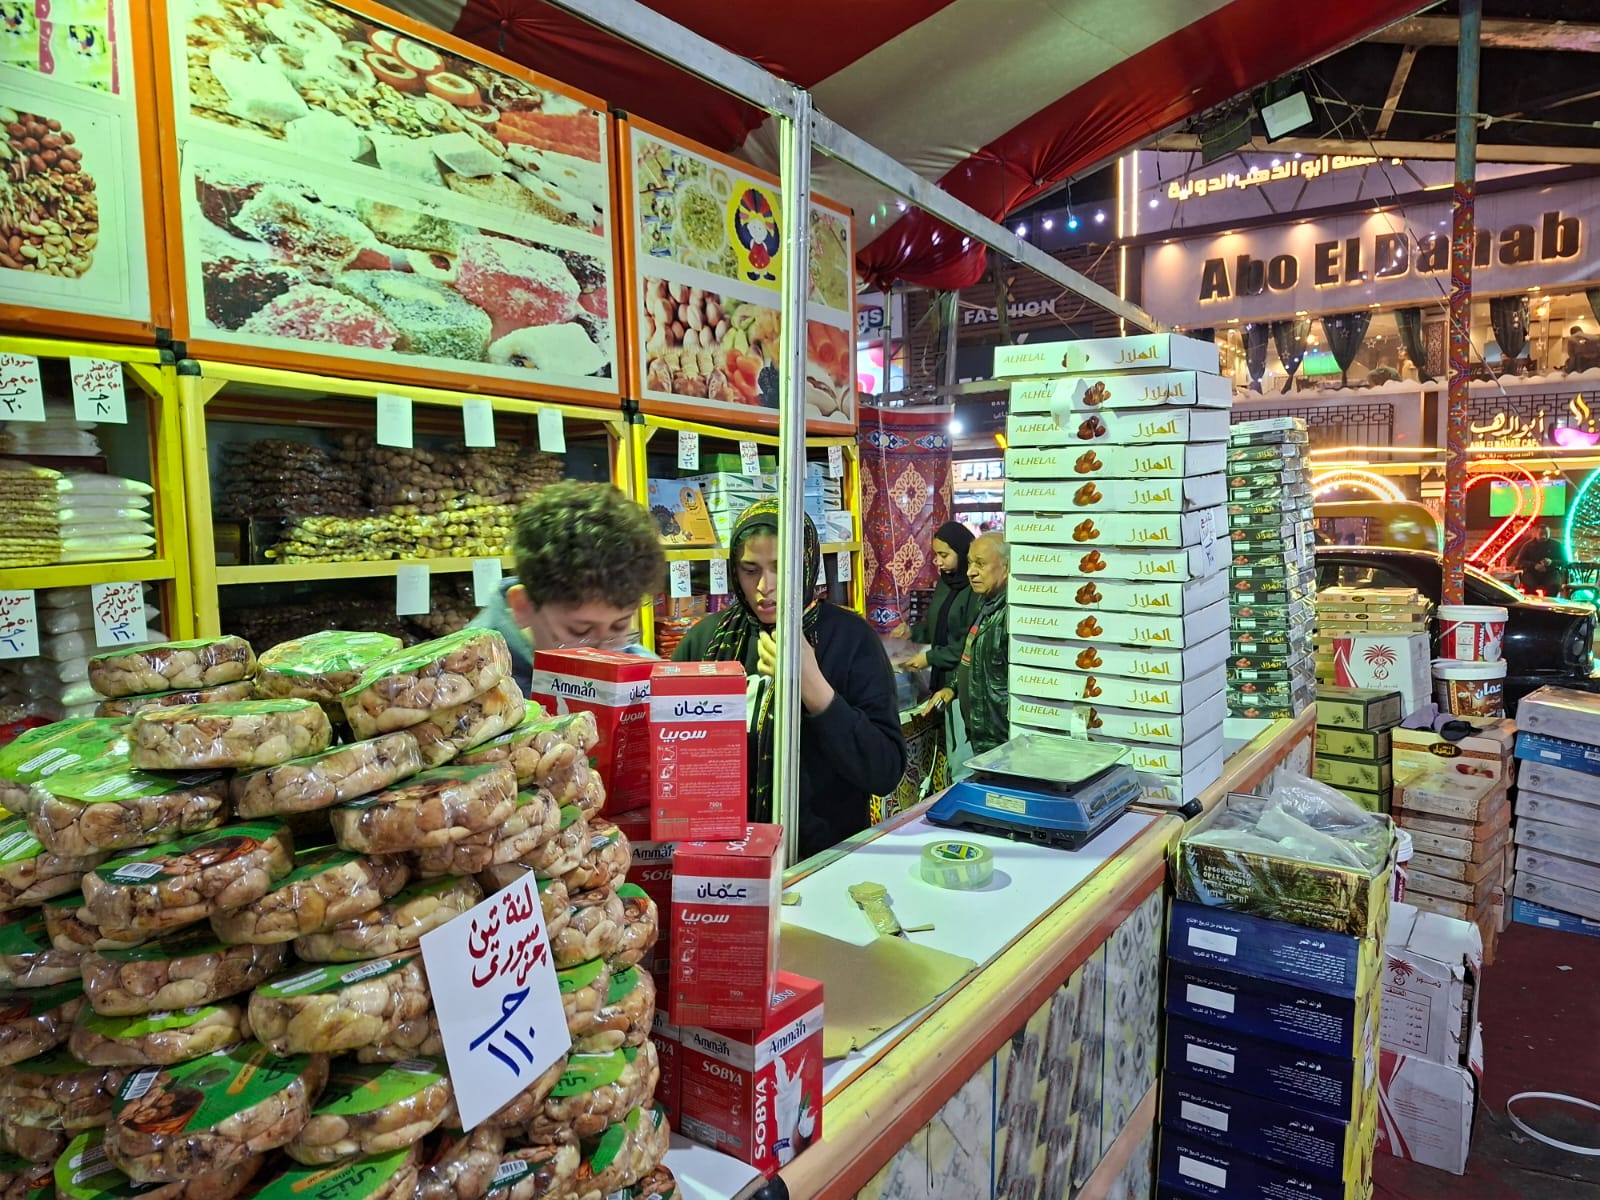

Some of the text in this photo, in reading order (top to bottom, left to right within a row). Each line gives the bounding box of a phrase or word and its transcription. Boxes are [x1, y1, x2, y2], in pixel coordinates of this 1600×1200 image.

[1200, 253, 1299, 302] Abo
[1114, 345, 1160, 365] الهلال
[1019, 388, 1052, 400] ALHEL
[1131, 419, 1181, 438] الهلال
[1128, 455, 1176, 473] الهلال
[1127, 487, 1175, 505] الهلال
[1013, 523, 1056, 532] ALHELAL
[1125, 526, 1172, 543] الهلال
[1018, 554, 1062, 563] ALHELAL
[1131, 559, 1179, 576] الهلال
[1016, 584, 1059, 594] ALHELAL
[1127, 592, 1176, 609] الهلال
[1016, 616, 1060, 627] ALHELAL
[1127, 627, 1175, 642] الهلال
[1017, 645, 1060, 657] ALHELAL
[1127, 659, 1174, 676] الهلال
[551, 677, 596, 699] Amman
[1016, 674, 1059, 686] ALHELAL
[1126, 688, 1173, 705] الهلال
[1017, 703, 1061, 717] ALHELAL
[658, 727, 708, 743] سوبيا
[1127, 721, 1174, 738] الهلال
[1129, 751, 1170, 769] الهلال
[640, 869, 673, 882] SOB
[680, 908, 730, 926] سوبيا
[693, 1032, 731, 1057] Amman
[769, 1021, 807, 1056] Amman
[487, 1025, 536, 1078] ١١٠
[653, 1038, 675, 1057] BYA
[701, 1059, 744, 1087] SOBYA
[754, 1077, 768, 1161] SOBYA
